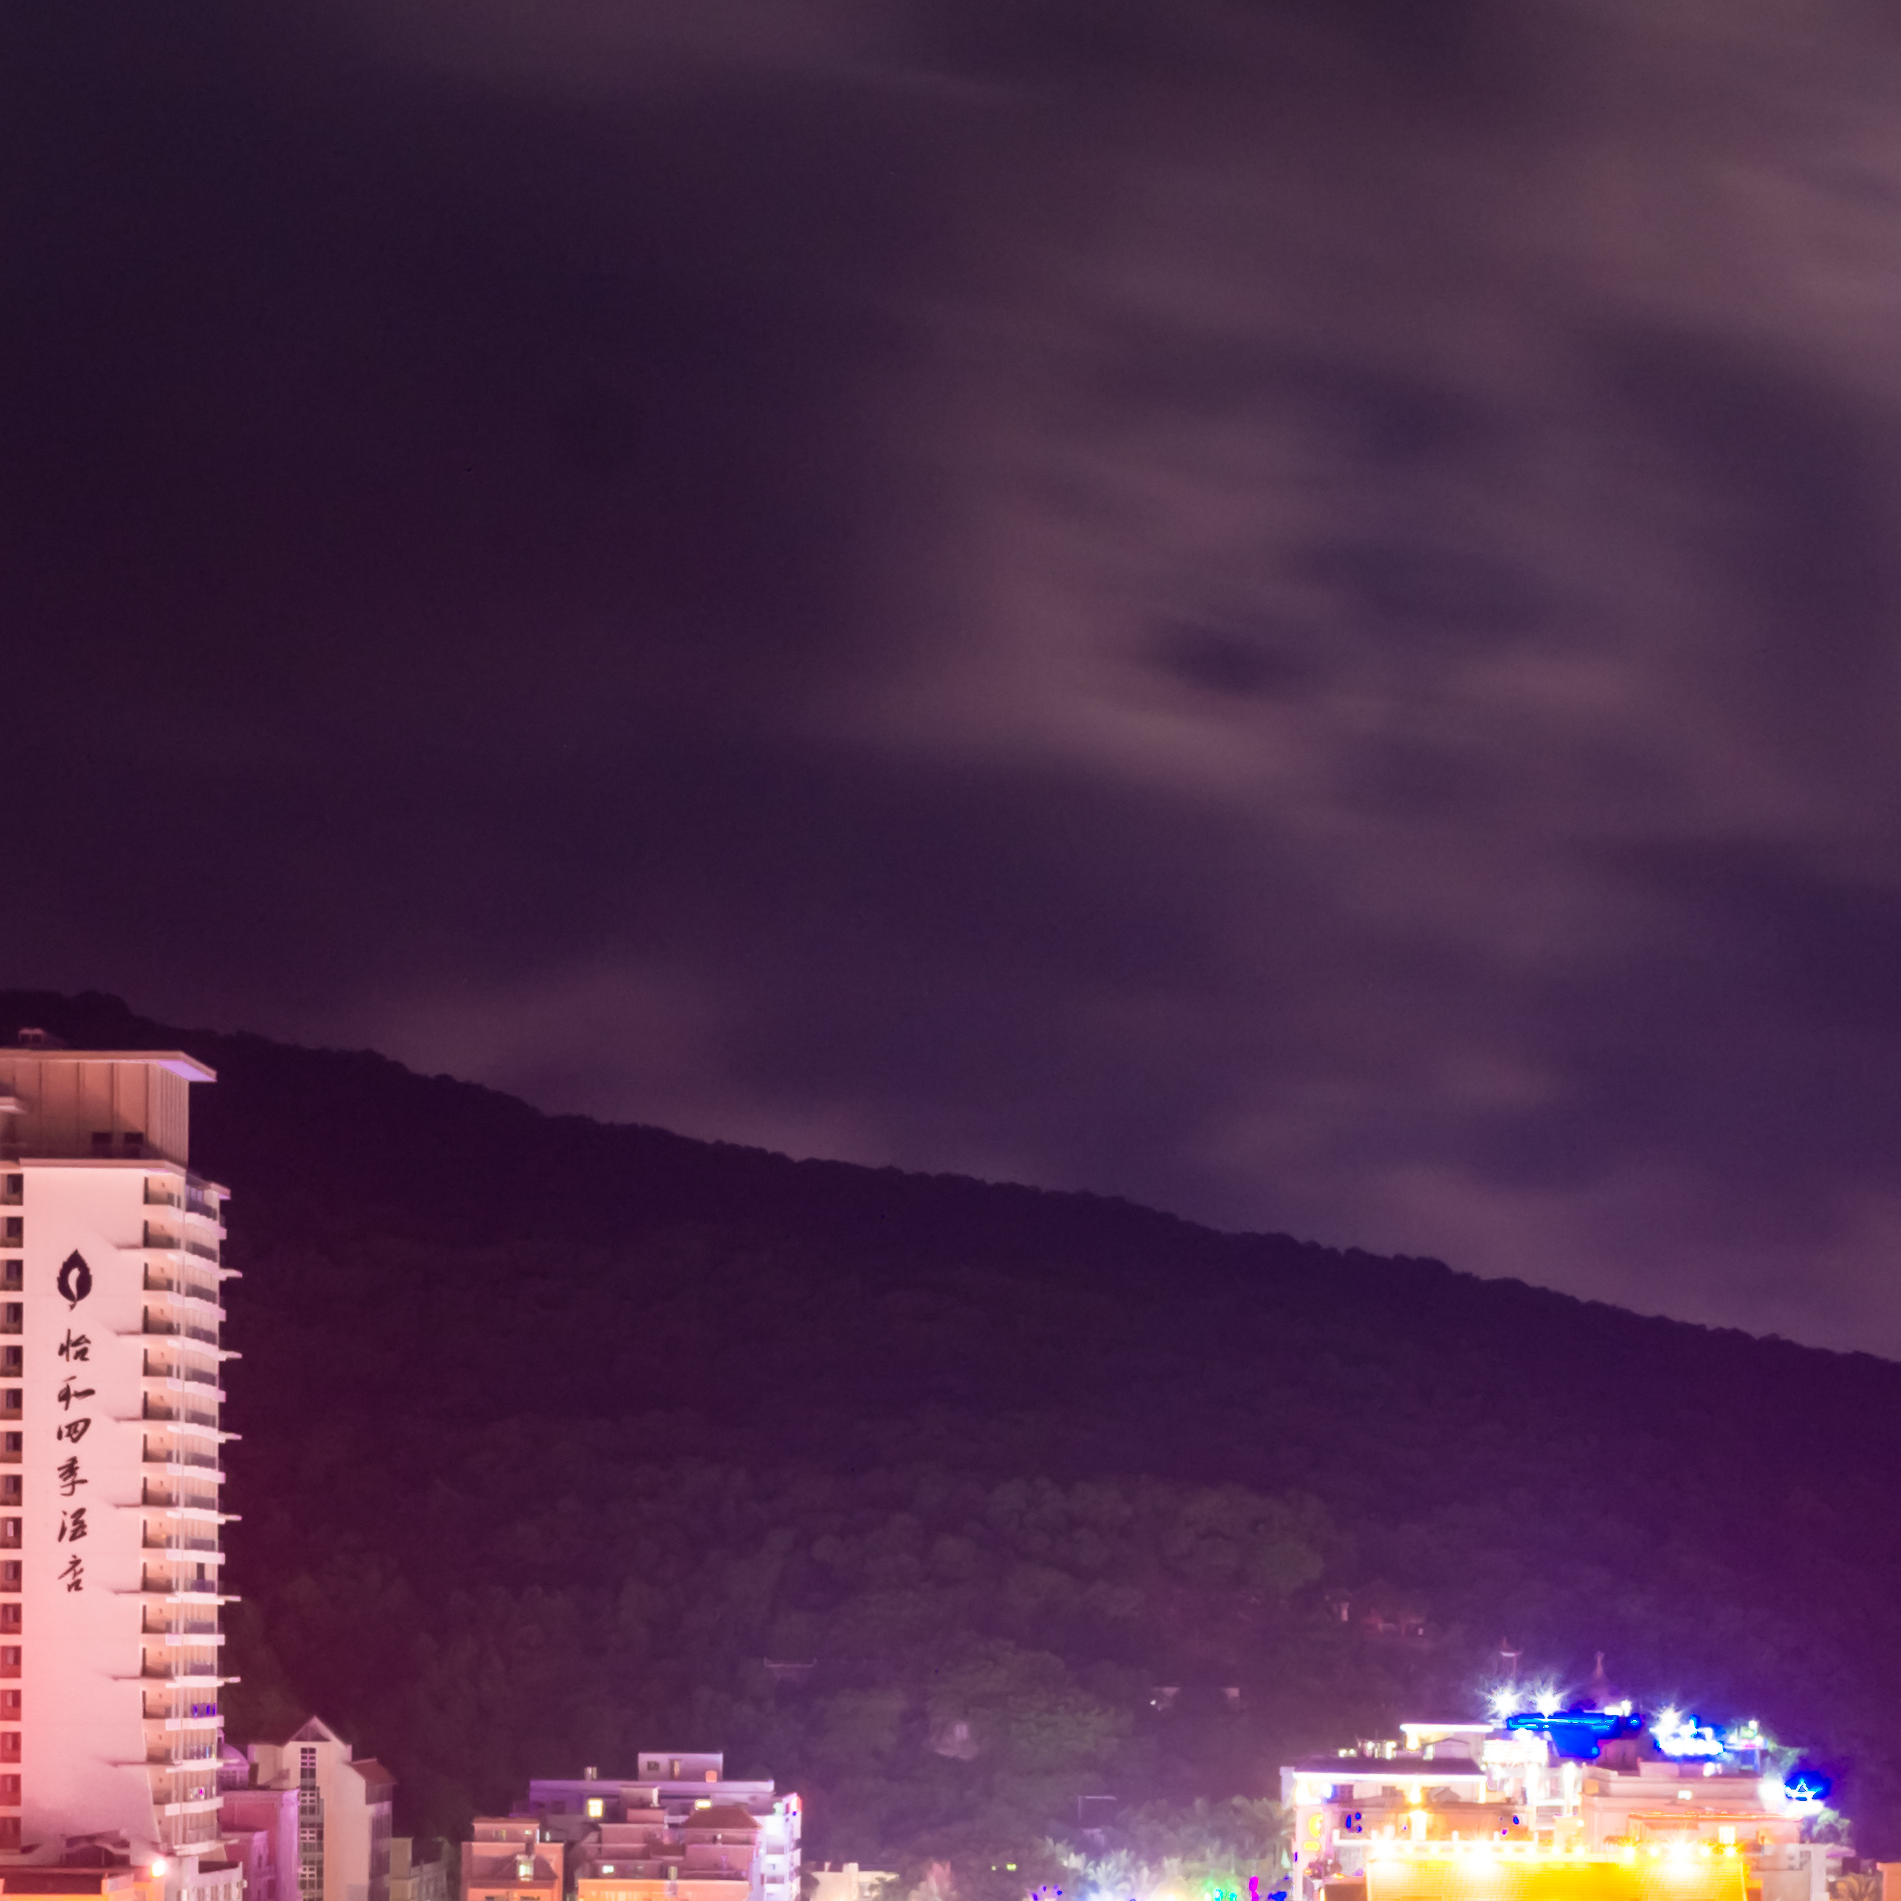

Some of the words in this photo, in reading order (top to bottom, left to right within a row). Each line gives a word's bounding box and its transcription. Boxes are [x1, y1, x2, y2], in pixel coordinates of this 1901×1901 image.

[57, 1329, 96, 1592] 怡和四季酒店
